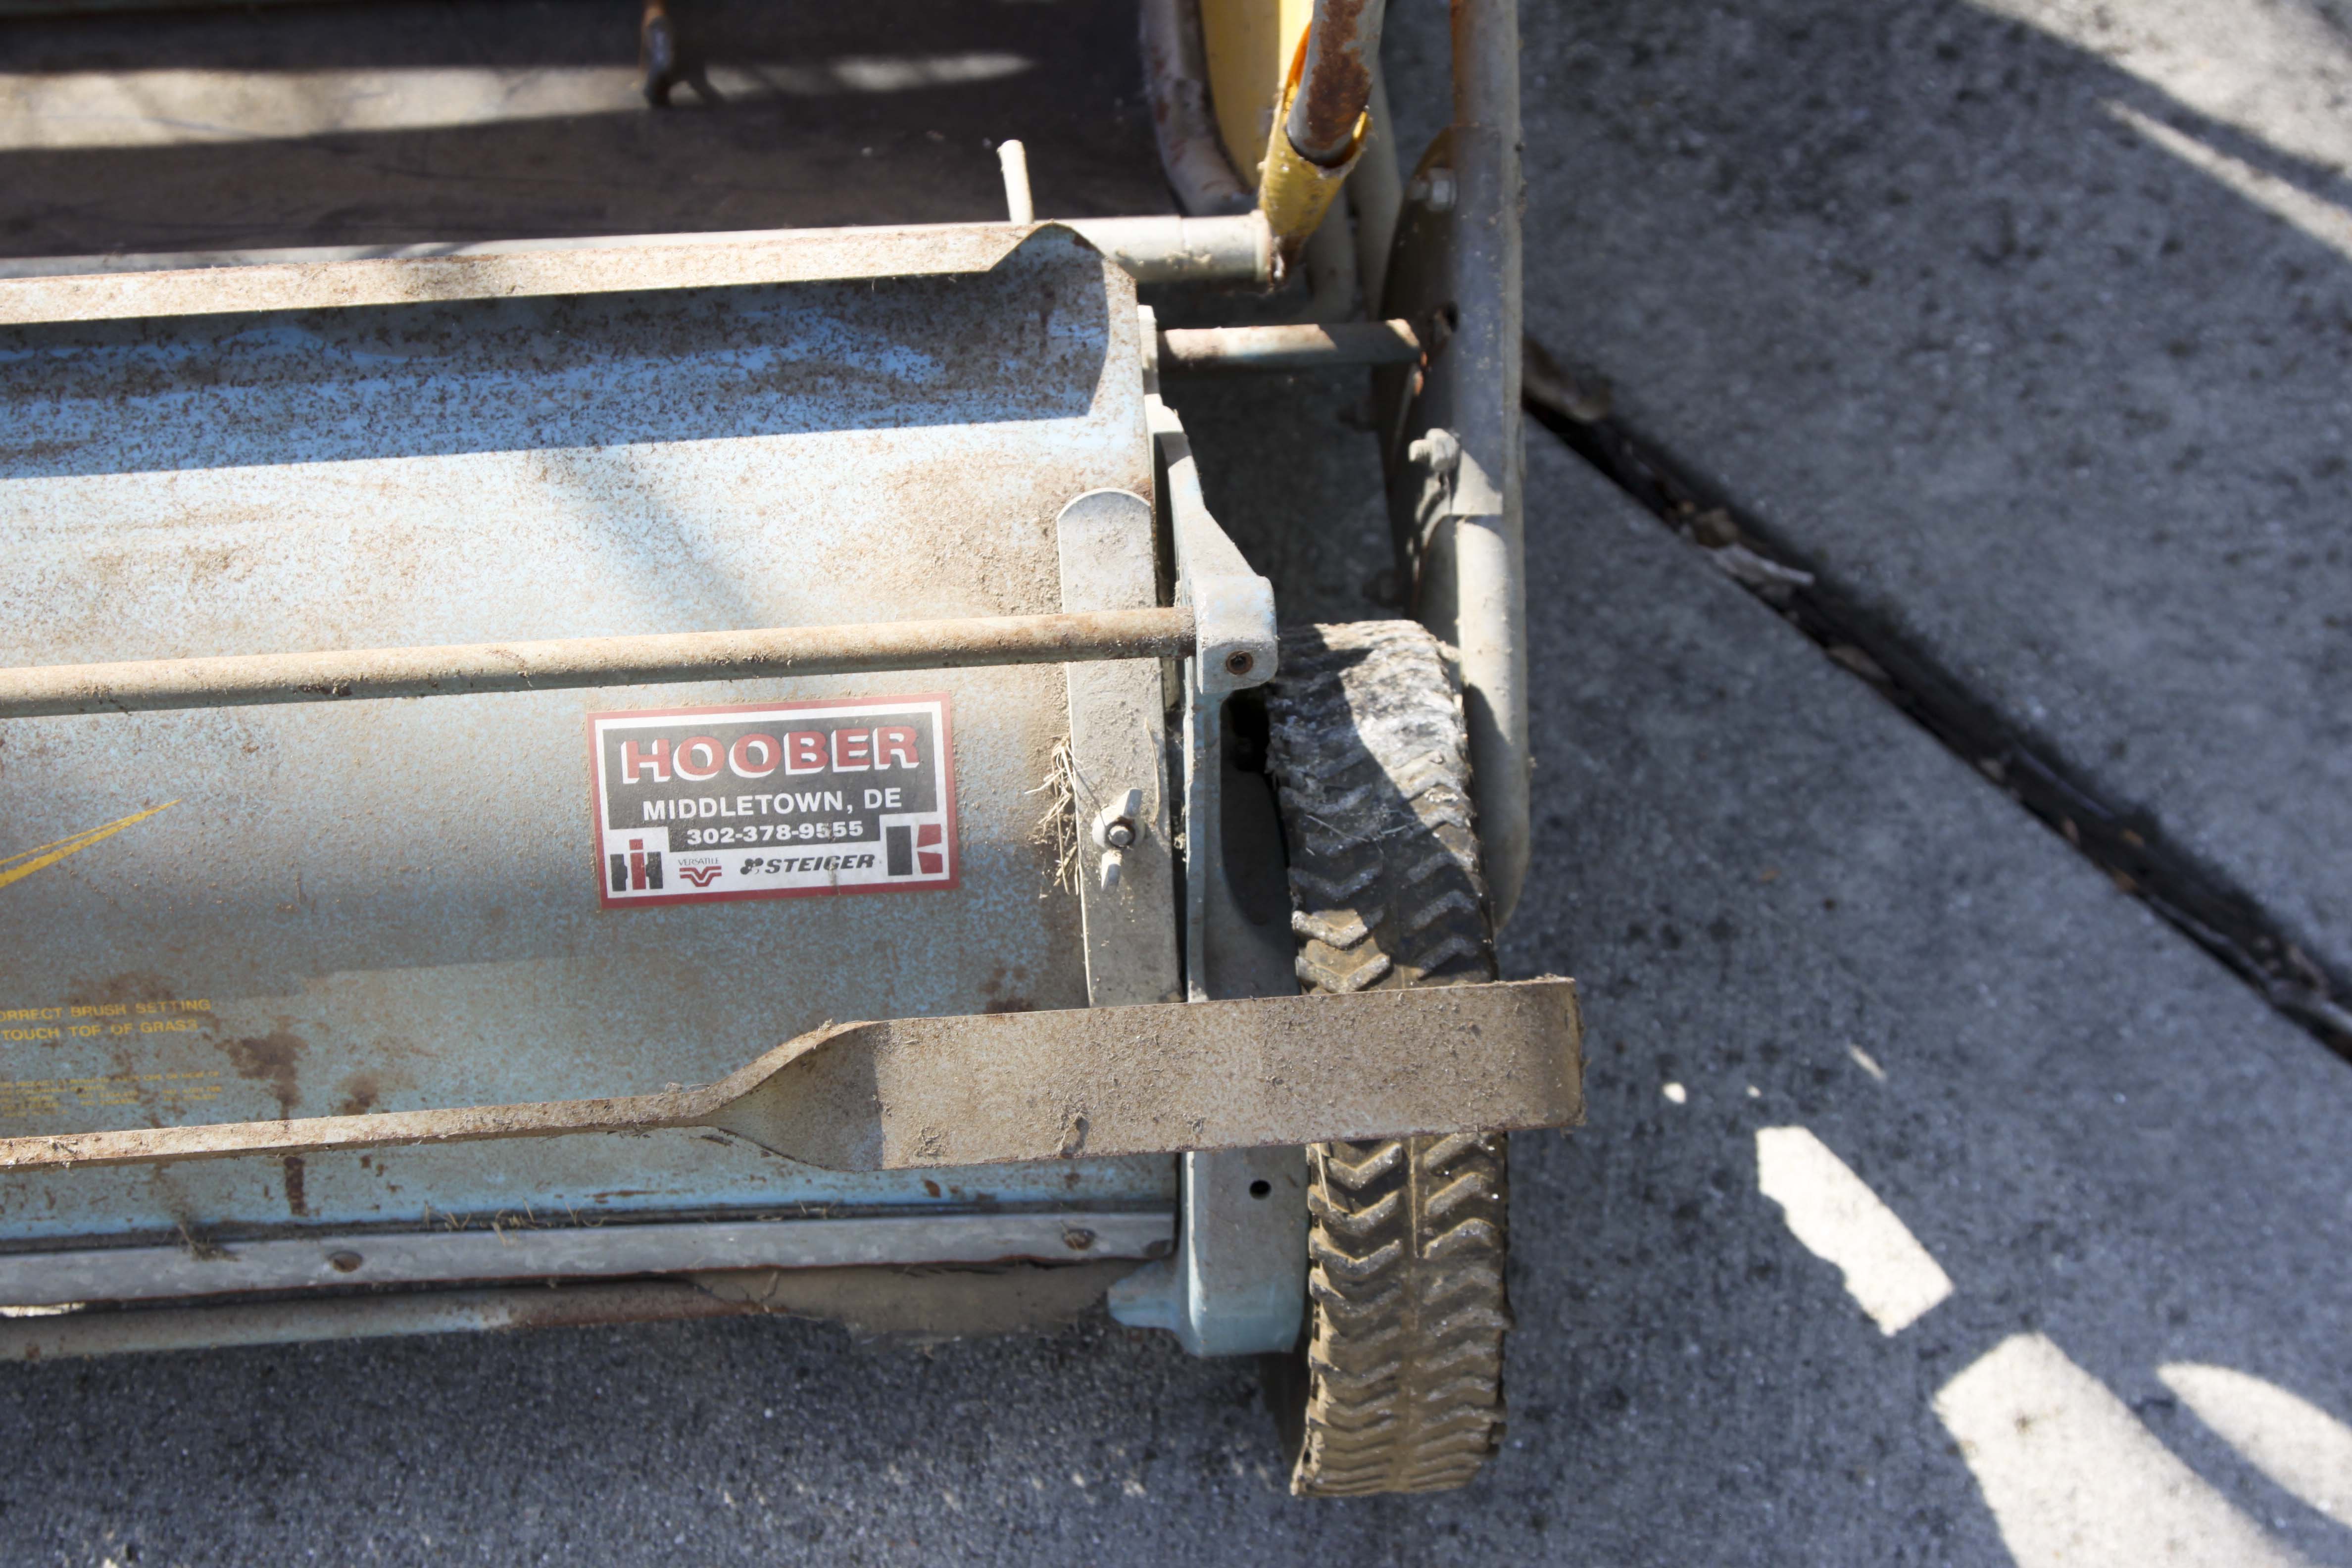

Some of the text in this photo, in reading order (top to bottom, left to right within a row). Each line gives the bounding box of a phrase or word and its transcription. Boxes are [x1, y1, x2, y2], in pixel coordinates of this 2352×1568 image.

[621, 726, 919, 784] HOOBER
[643, 787, 901, 821] MIDDLETOWN, DE
[687, 821, 863, 845] 302-378-9555
[678, 857, 720, 866] VERSATILE
[765, 854, 875, 874] STEIGER
[71, 1004, 127, 1018] BRUSH
[136, 999, 211, 1014] SETTING
[2, 1019, 198, 1041] TOUCH TOP OF GRASS
